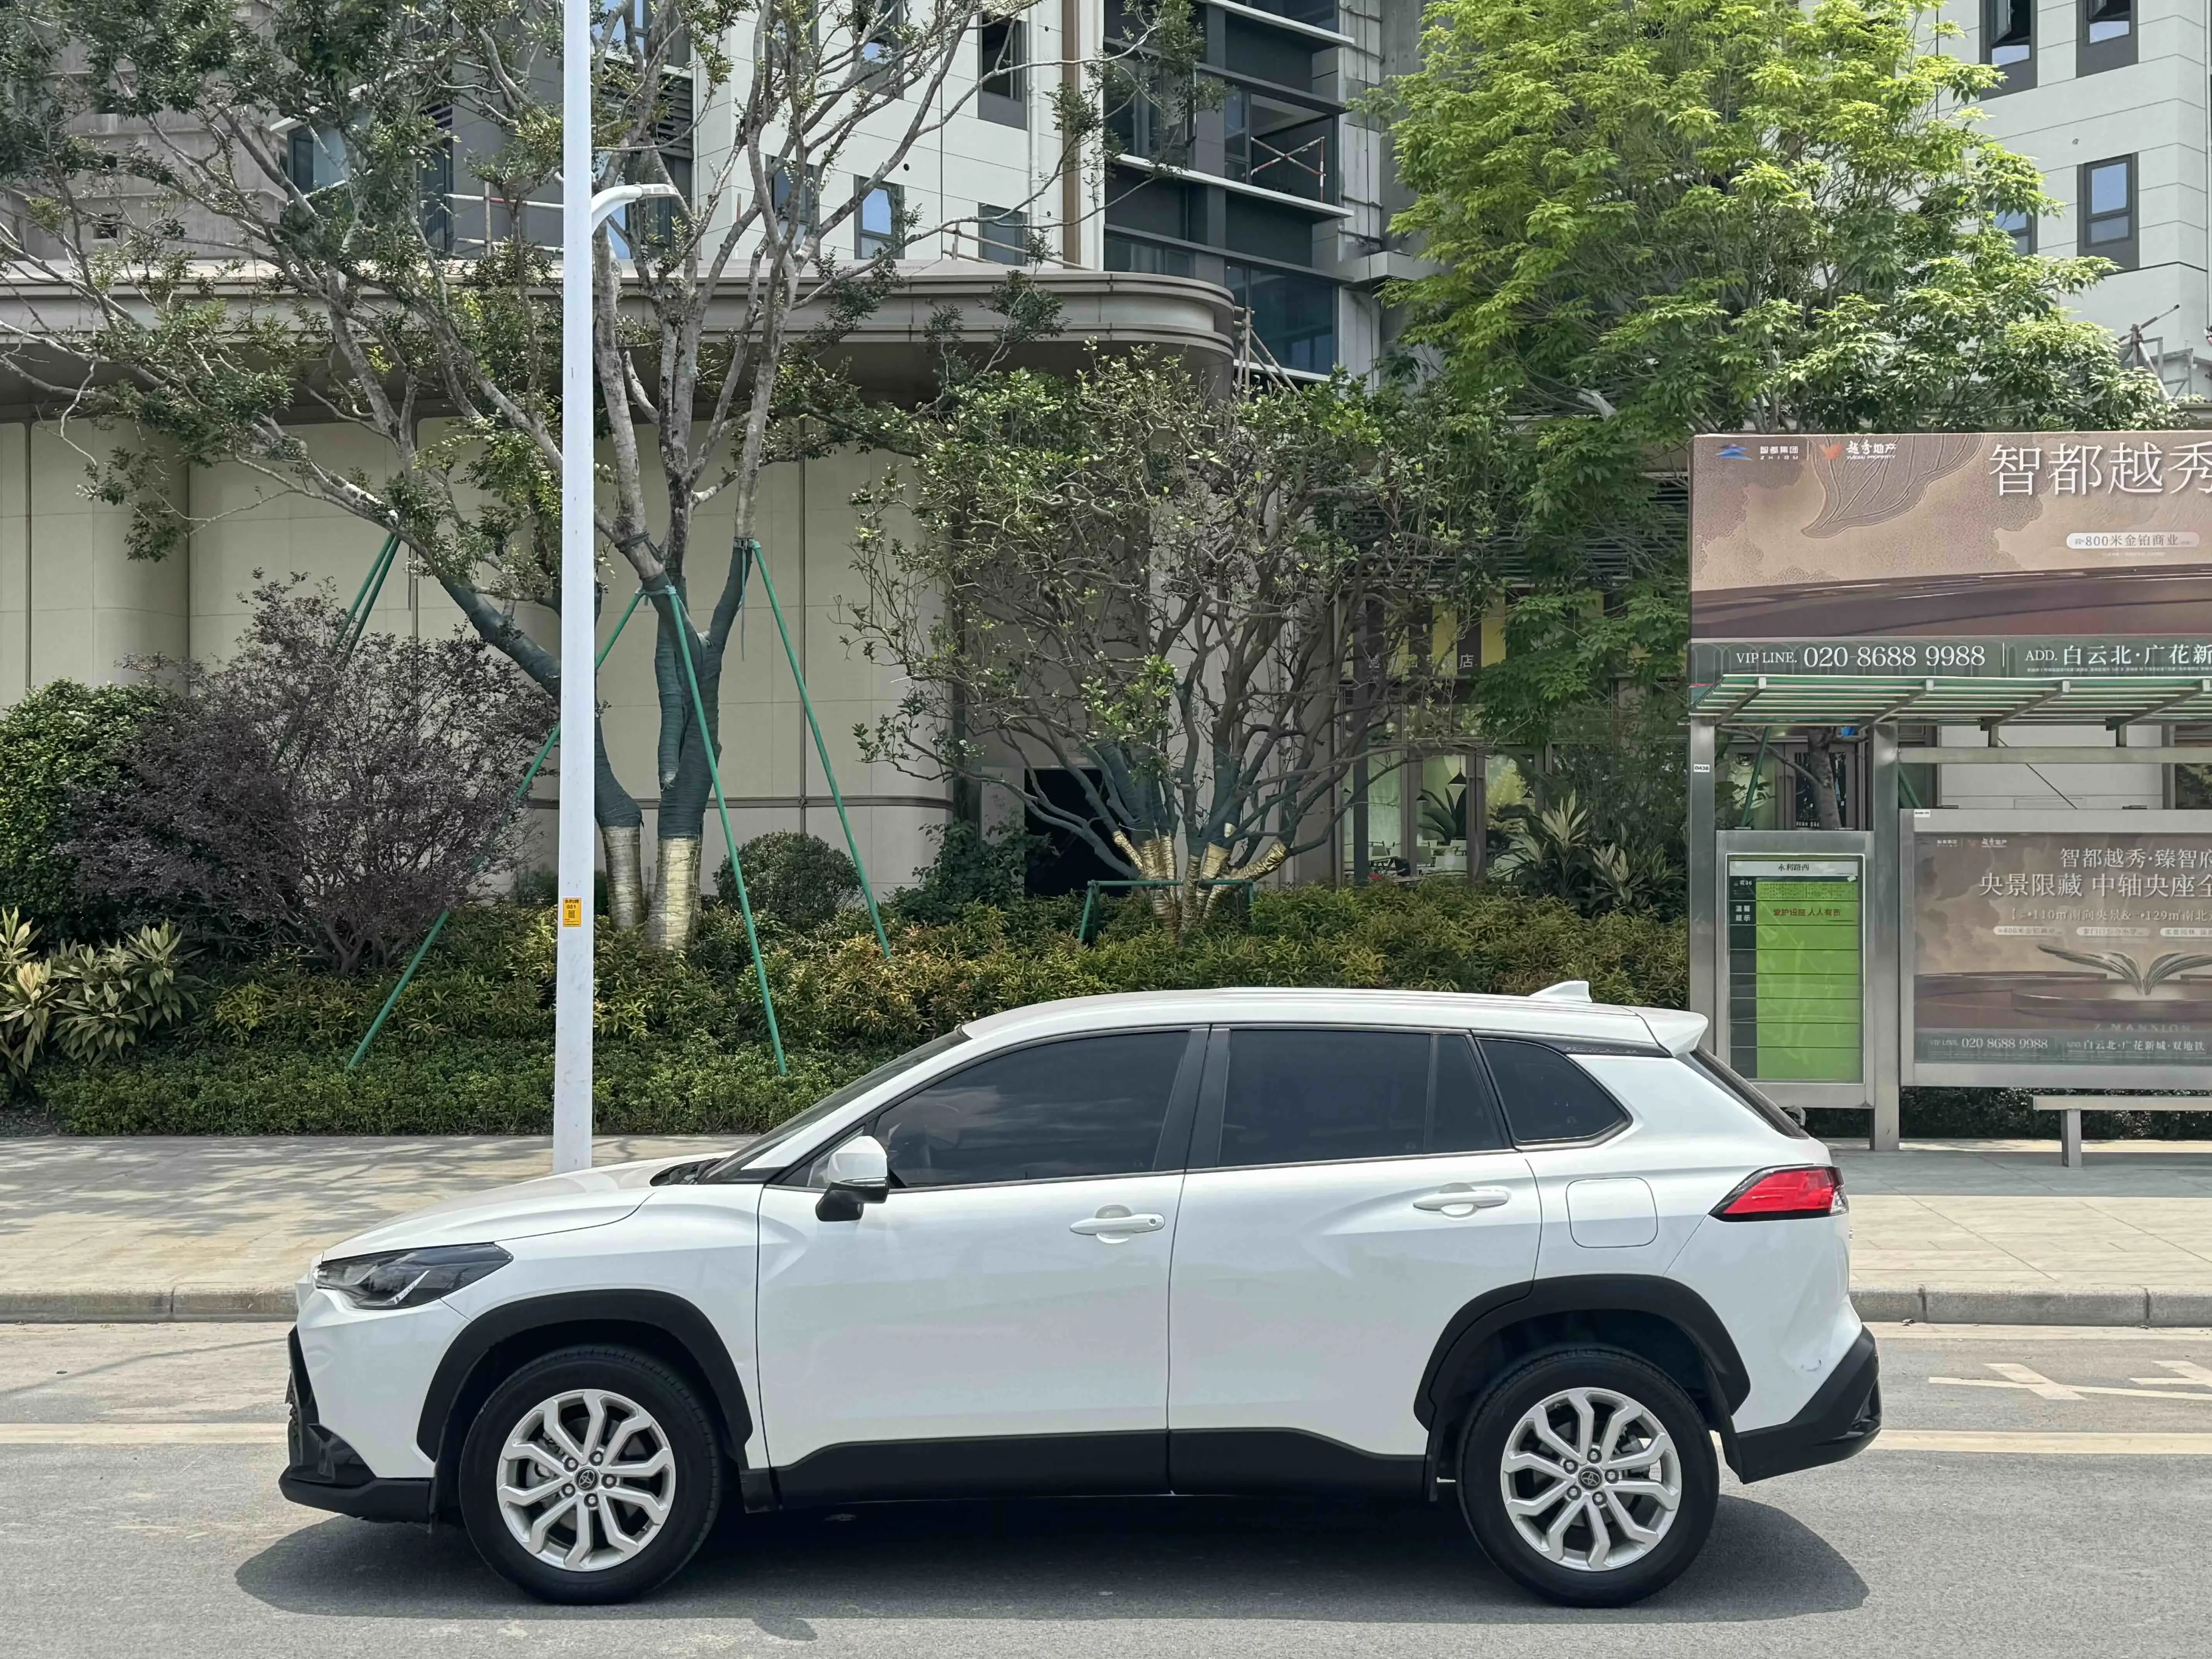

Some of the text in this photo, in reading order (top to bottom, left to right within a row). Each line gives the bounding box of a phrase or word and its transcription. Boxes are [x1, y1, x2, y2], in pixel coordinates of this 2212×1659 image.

[1846, 439, 1896, 454] 越秀地产
[1989, 441, 2212, 496] 智都越秀
[1736, 652, 1759, 663] VIP
[1762, 652, 1797, 663] LINE.
[1925, 646, 1985, 666] 9988
[2024, 650, 2057, 661] ADD.
[1978, 872, 2082, 897] 央景限藏
